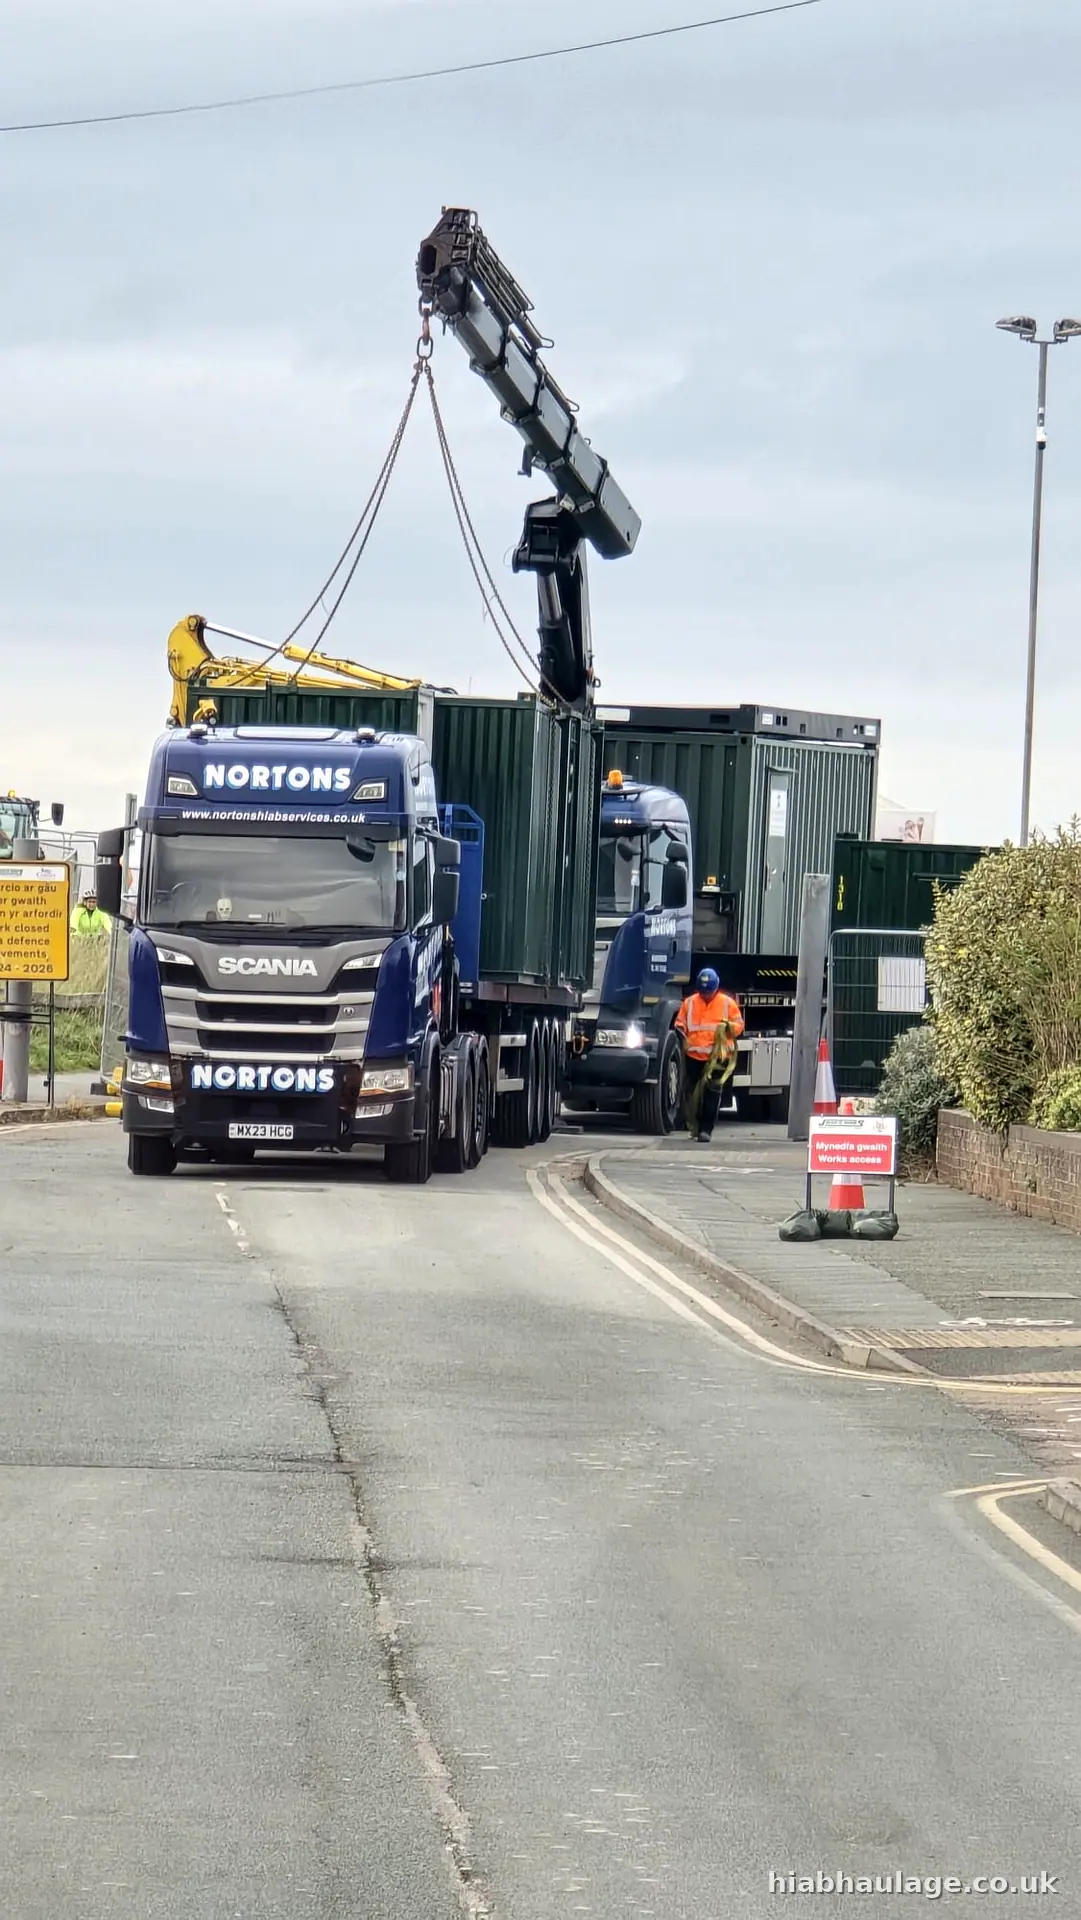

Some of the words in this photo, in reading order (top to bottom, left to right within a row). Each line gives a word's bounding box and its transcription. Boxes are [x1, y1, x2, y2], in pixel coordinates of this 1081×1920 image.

[203, 764, 351, 792] NORTONS
[181, 810, 366, 824] www.nortonshiabservices.co.uk
[10, 896, 47, 906] gwaith
[9, 910, 20, 919] yr
[23, 909, 62, 918] arfordir
[14, 923, 50, 933] closed
[7, 936, 50, 946] defence
[23, 964, 54, 973] 2026
[217, 957, 318, 976] SCANIA
[191, 1064, 335, 1093] NORTONS
[236, 1125, 267, 1137] MX23
[269, 1126, 292, 1138] HCG
[815, 1141, 855, 1152] Mynedfa
[856, 1142, 888, 1153] gwaith
[818, 1154, 848, 1163] Works
[849, 1155, 882, 1164] access
